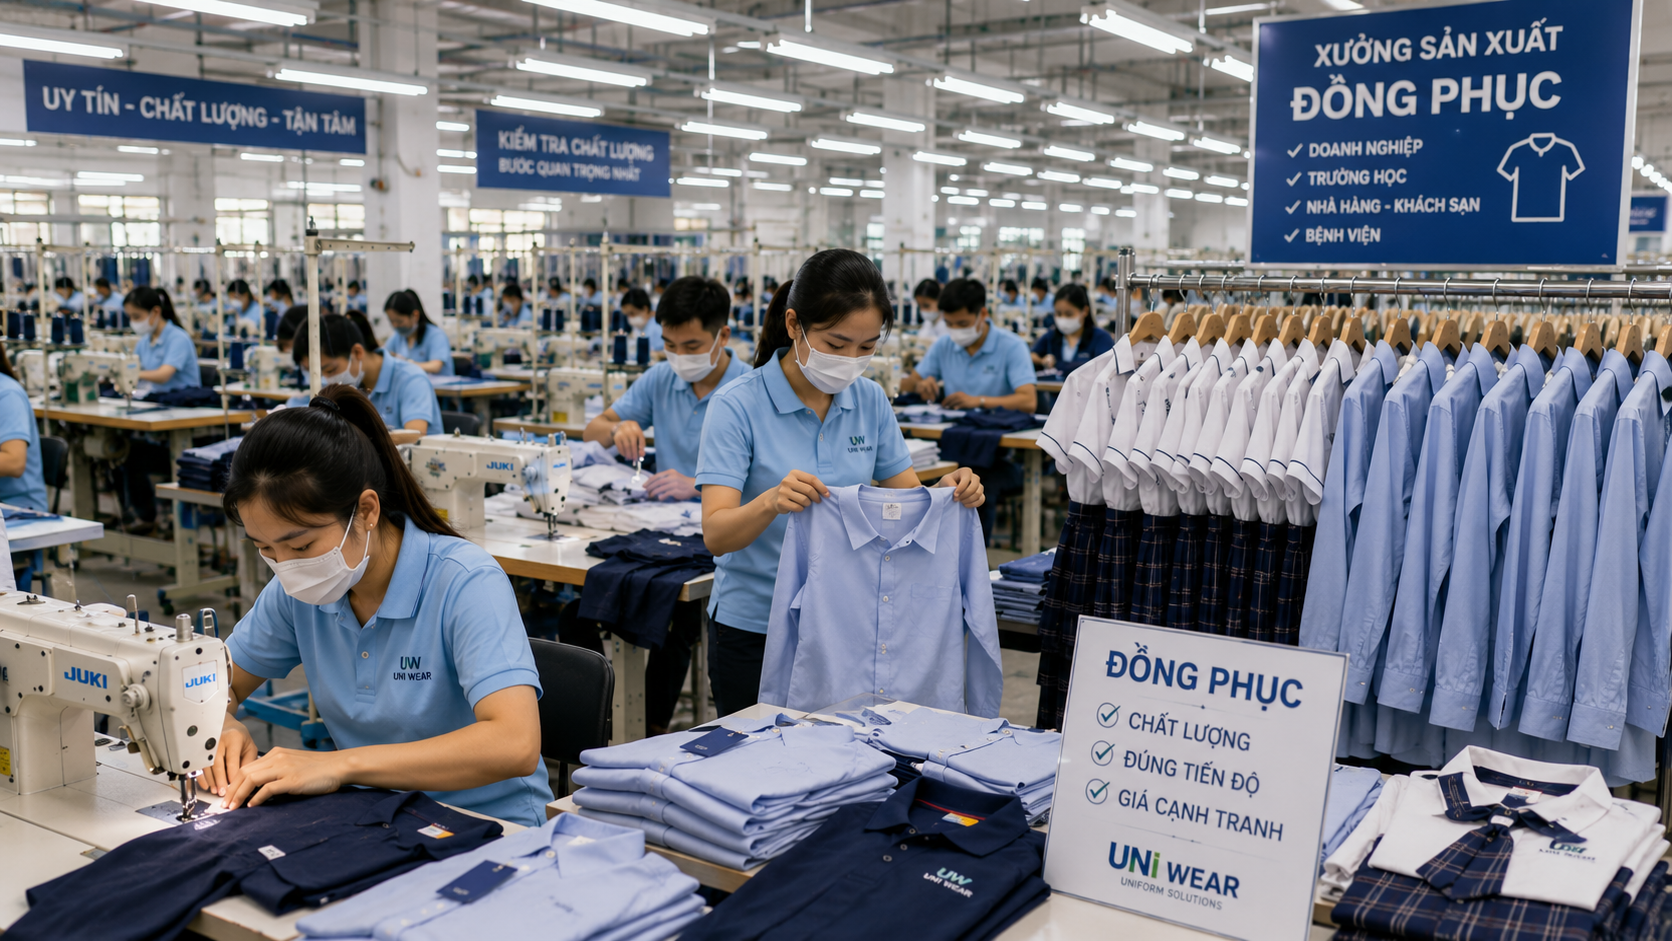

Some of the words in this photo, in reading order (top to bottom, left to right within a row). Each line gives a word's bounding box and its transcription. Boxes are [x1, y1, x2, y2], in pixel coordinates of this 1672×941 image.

[1314, 33, 1412, 68] XƯỞNG
[1419, 26, 1478, 60] SẢN
[1484, 17, 1564, 56] XUẤT
[1290, 73, 1417, 122] ĐỒNG
[1431, 71, 1563, 120] PHỤC
[42, 86, 76, 112] UY
[81, 86, 120, 116] TÍN
[140, 92, 196, 122] CHẤT
[200, 101, 268, 131] LƯỢNG
[282, 106, 318, 136] TẬN
[321, 110, 356, 136] TÂM
[539, 134, 569, 155] TRA
[1309, 141, 1362, 158] DOANH
[1365, 135, 1423, 158] NGHIỆP
[537, 160, 571, 178] QUAN
[1307, 167, 1370, 186] TRƯỜNG
[1373, 168, 1407, 187] HỌC
[1306, 196, 1337, 214] NHÀ
[1340, 195, 1381, 214] HÀNG
[1394, 194, 1446, 213] KHÁCH
[1449, 197, 1481, 216] SẠN
[1305, 225, 1344, 246] BỆNH
[1347, 225, 1381, 246] VIỆN
[486, 461, 514, 471] JUKI
[400, 656, 421, 670] UW
[64, 666, 108, 690] JUKI
[185, 672, 216, 689] JUKI
[393, 672, 406, 681] UNI
[407, 671, 432, 681] WEAR
[1105, 642, 1199, 690] ĐỒNG
[1208, 666, 1304, 712] PHỤC
[1128, 711, 1179, 737] CHẤT
[1183, 722, 1251, 751] LƯỢNG
[1123, 750, 1177, 777] ĐÚNG
[1183, 761, 1226, 788] TIẾN
[1230, 772, 1260, 798] ĐỘ
[1118, 789, 1149, 812] GIÁ
[1155, 797, 1210, 826] CẠNH
[1215, 809, 1284, 842] TRANH
[936, 867, 973, 885] UW
[1166, 861, 1241, 899] WEAR
[943, 880, 974, 898] WEAR
[1120, 876, 1165, 896] UNIFORM
[1167, 888, 1223, 911] SOLUTIONS
